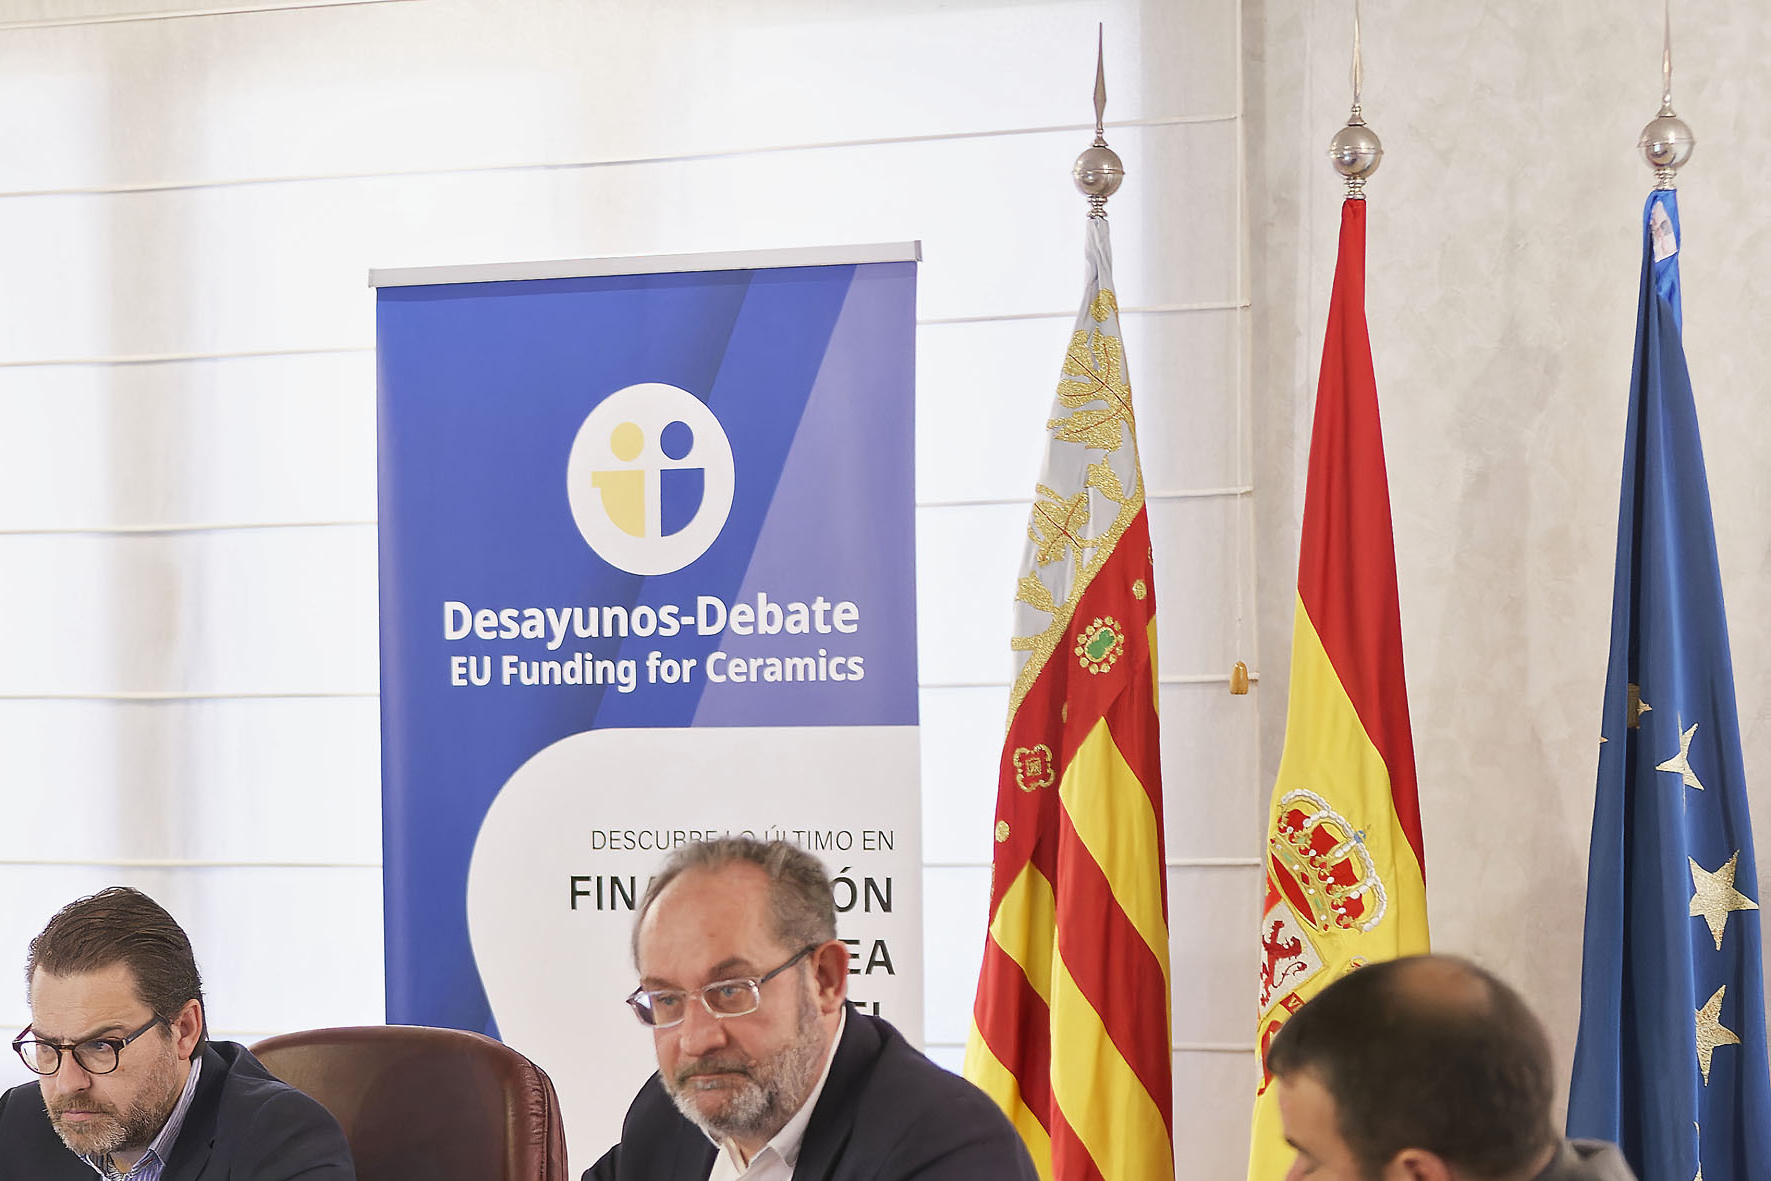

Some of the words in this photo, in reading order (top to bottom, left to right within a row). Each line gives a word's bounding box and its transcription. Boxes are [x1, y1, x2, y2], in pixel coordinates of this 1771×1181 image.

[443, 592, 861, 651] Desayunos-Debate
[450, 655, 492, 687] EU
[500, 651, 638, 694] Funding
[645, 650, 698, 684] for
[705, 648, 865, 684] Ceramics
[862, 829, 895, 851] EN
